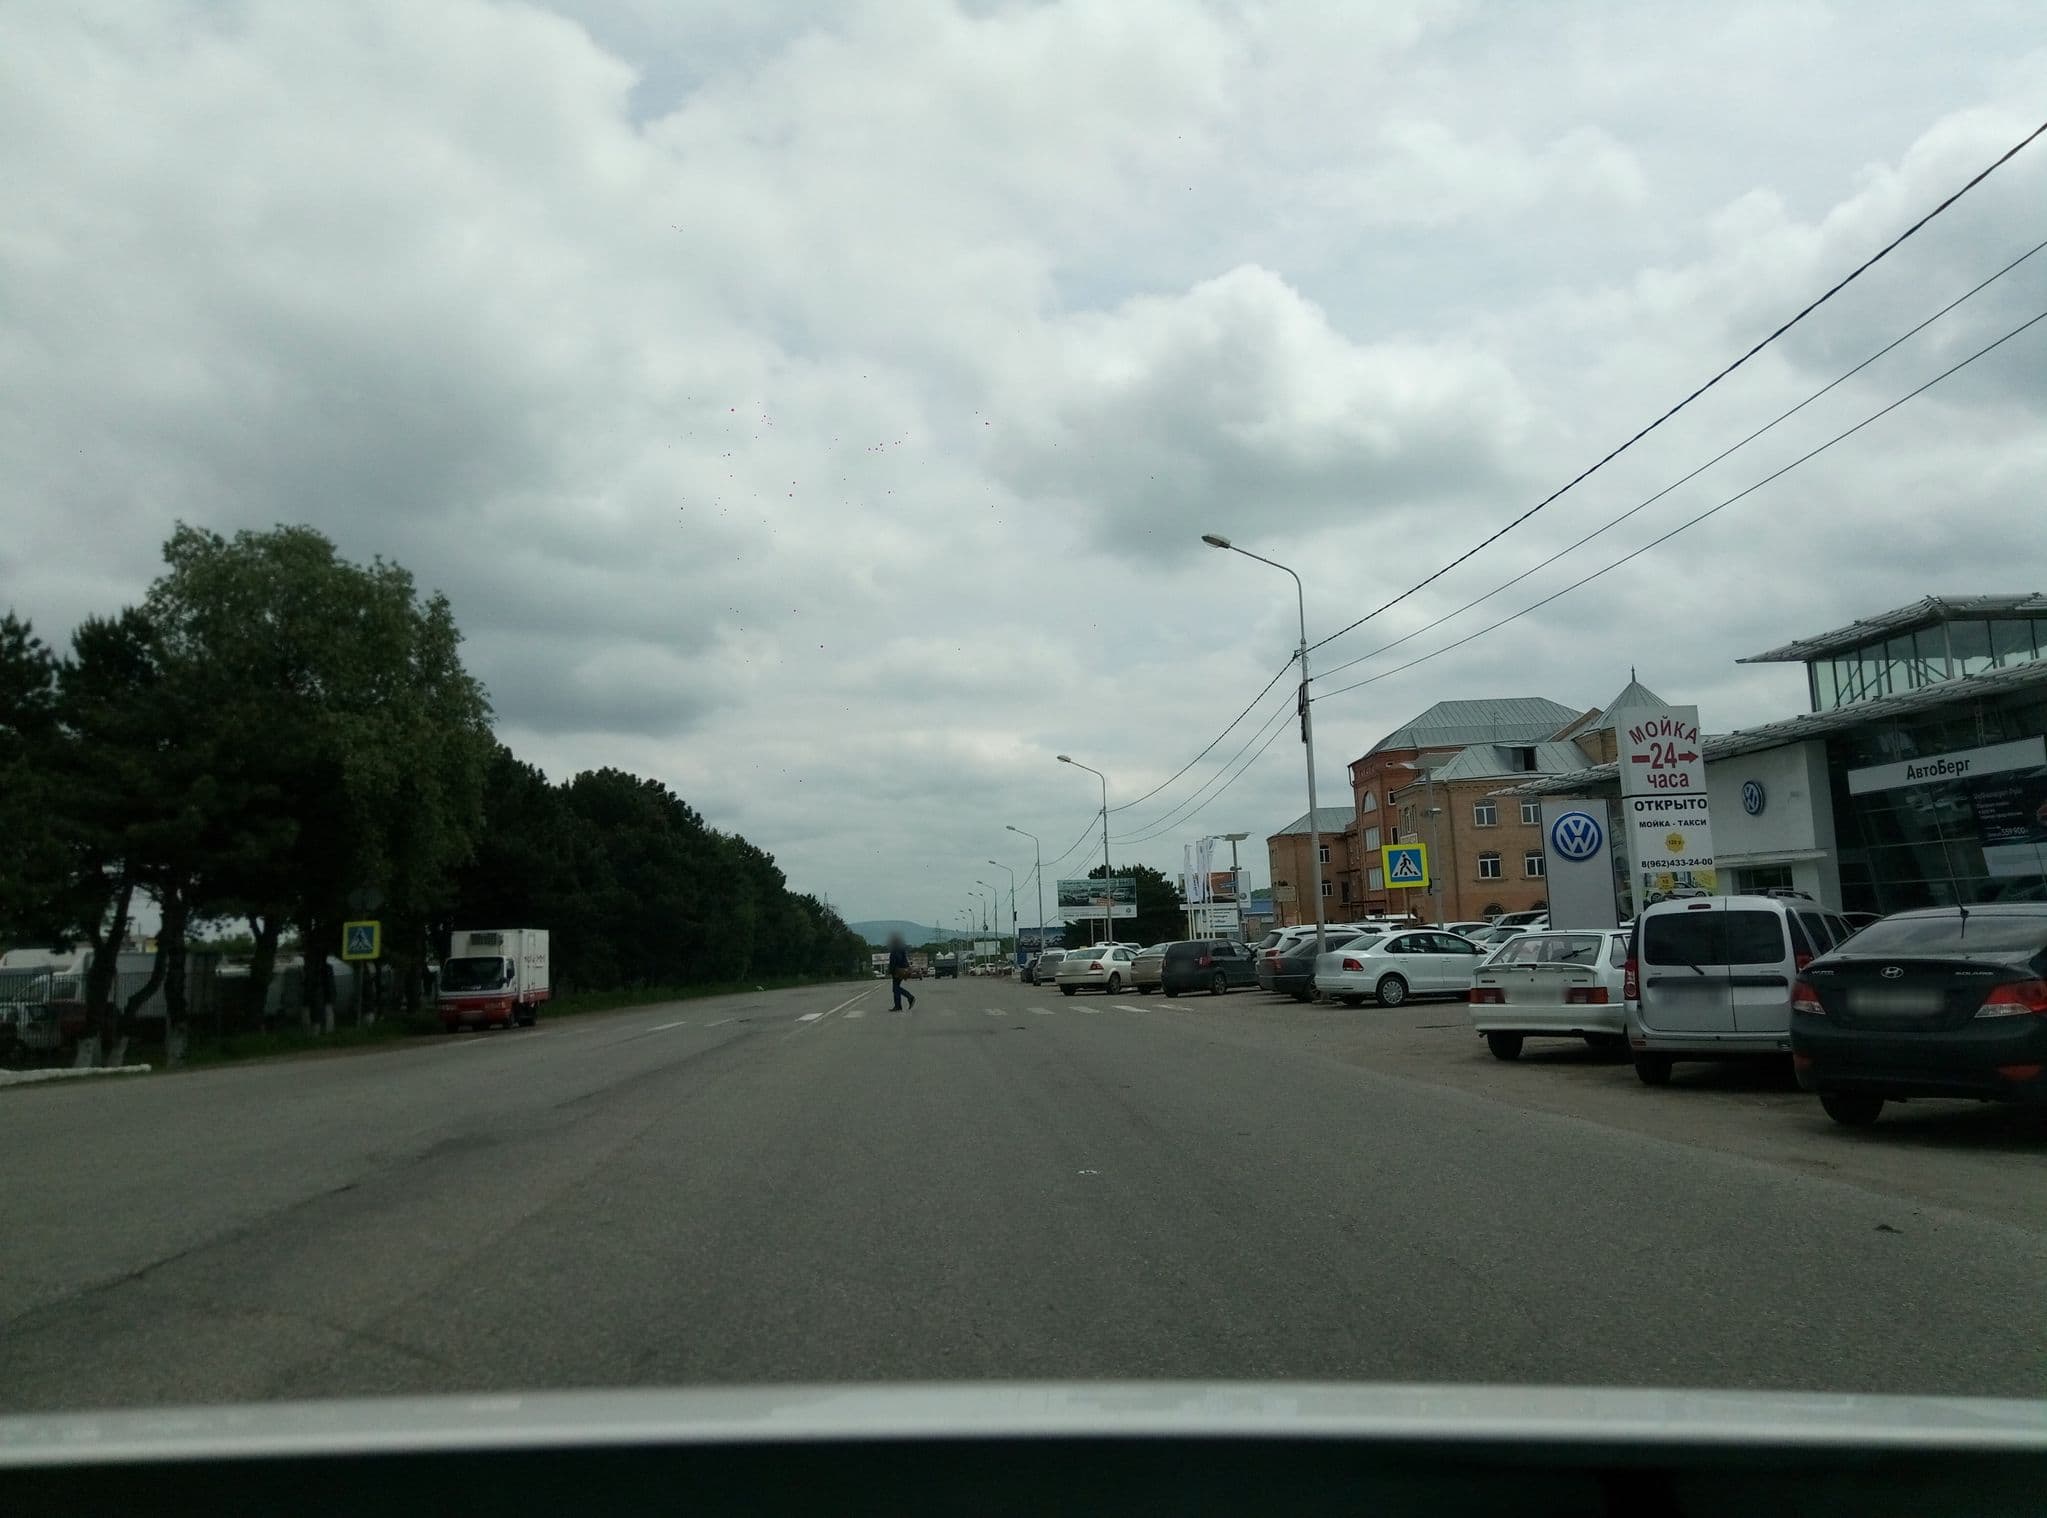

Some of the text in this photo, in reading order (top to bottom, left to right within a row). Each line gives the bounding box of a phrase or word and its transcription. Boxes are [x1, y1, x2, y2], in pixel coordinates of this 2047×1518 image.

[1628, 715, 1697, 744] МОЙКА
[1650, 742, 1678, 769] 24
[1906, 759, 1971, 780] АвтоБерг
[1646, 772, 1689, 788] часа
[1634, 799, 1707, 811] ОТКРЫТО
[1639, 820, 1671, 828] МОЙКА
[1677, 819, 1707, 827] ТАКСИ
[1641, 858, 1713, 868] 8(962)433-24-00
